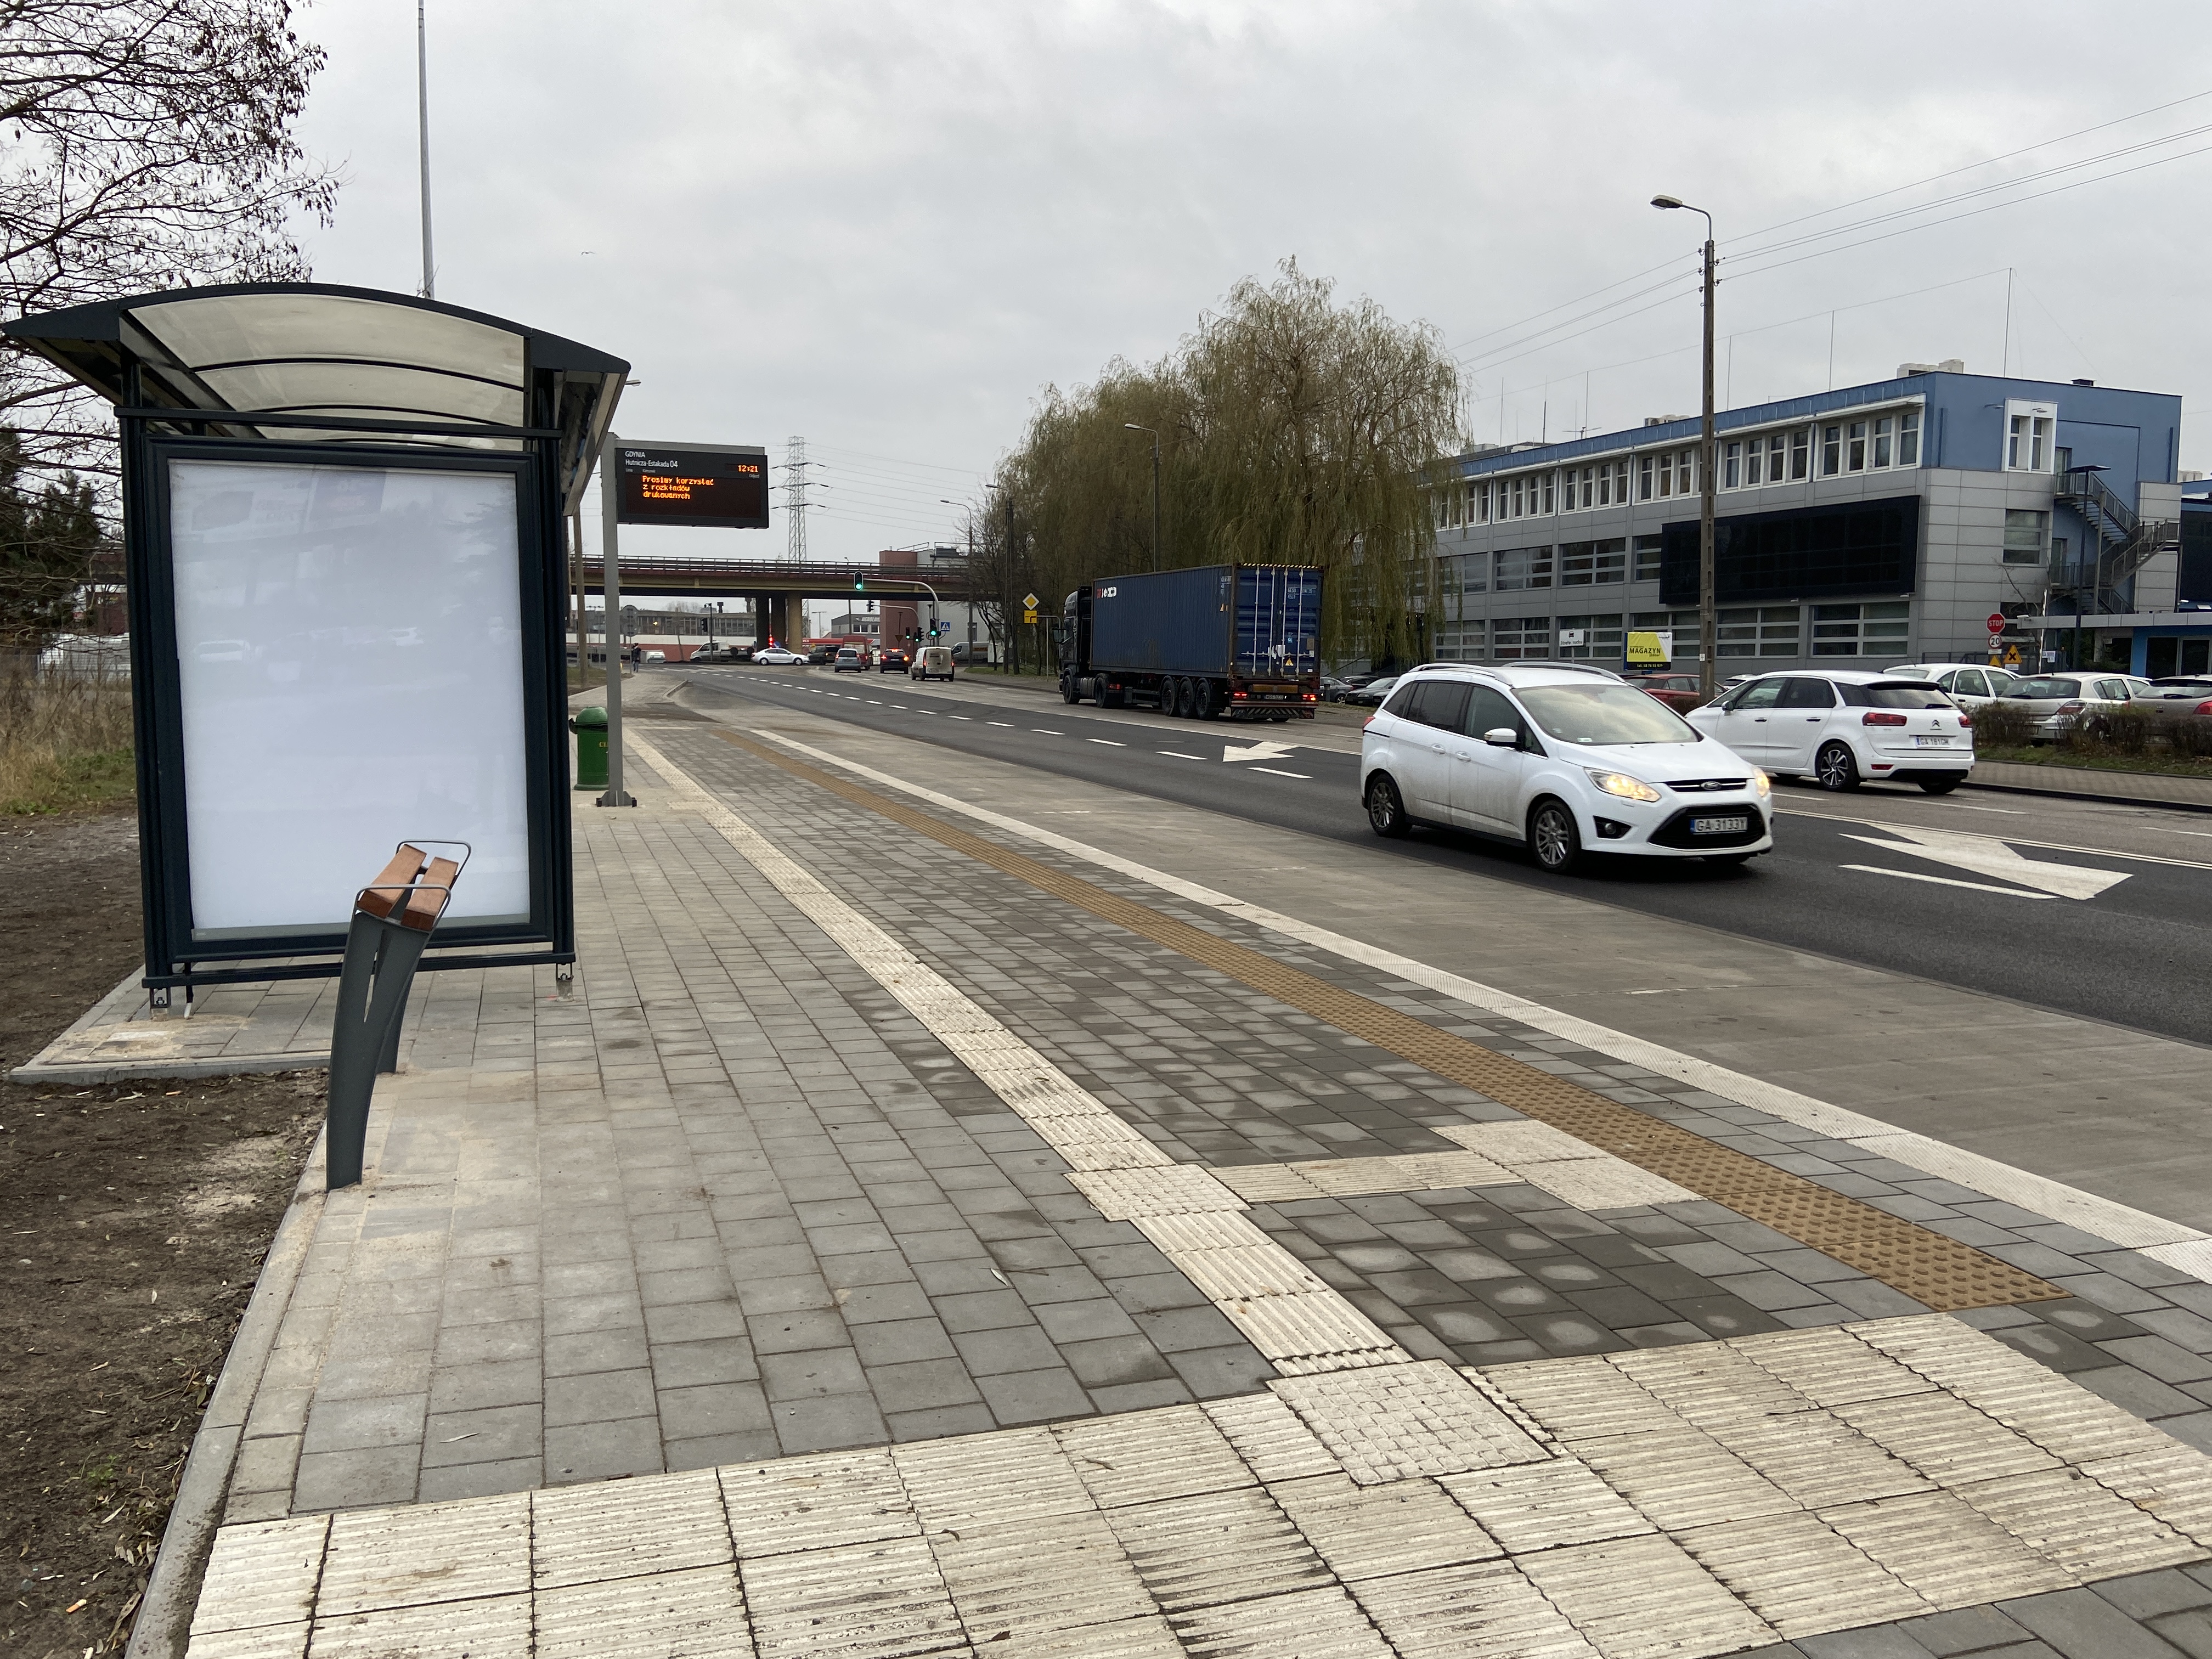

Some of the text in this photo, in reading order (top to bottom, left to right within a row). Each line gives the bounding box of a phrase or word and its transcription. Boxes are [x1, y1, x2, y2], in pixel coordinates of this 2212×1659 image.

[669, 460, 678, 468] 04
[642, 475, 714, 486] Prosimy korzystać
[642, 490, 690, 499] drukowanych
[1696, 820, 1712, 832] GA
